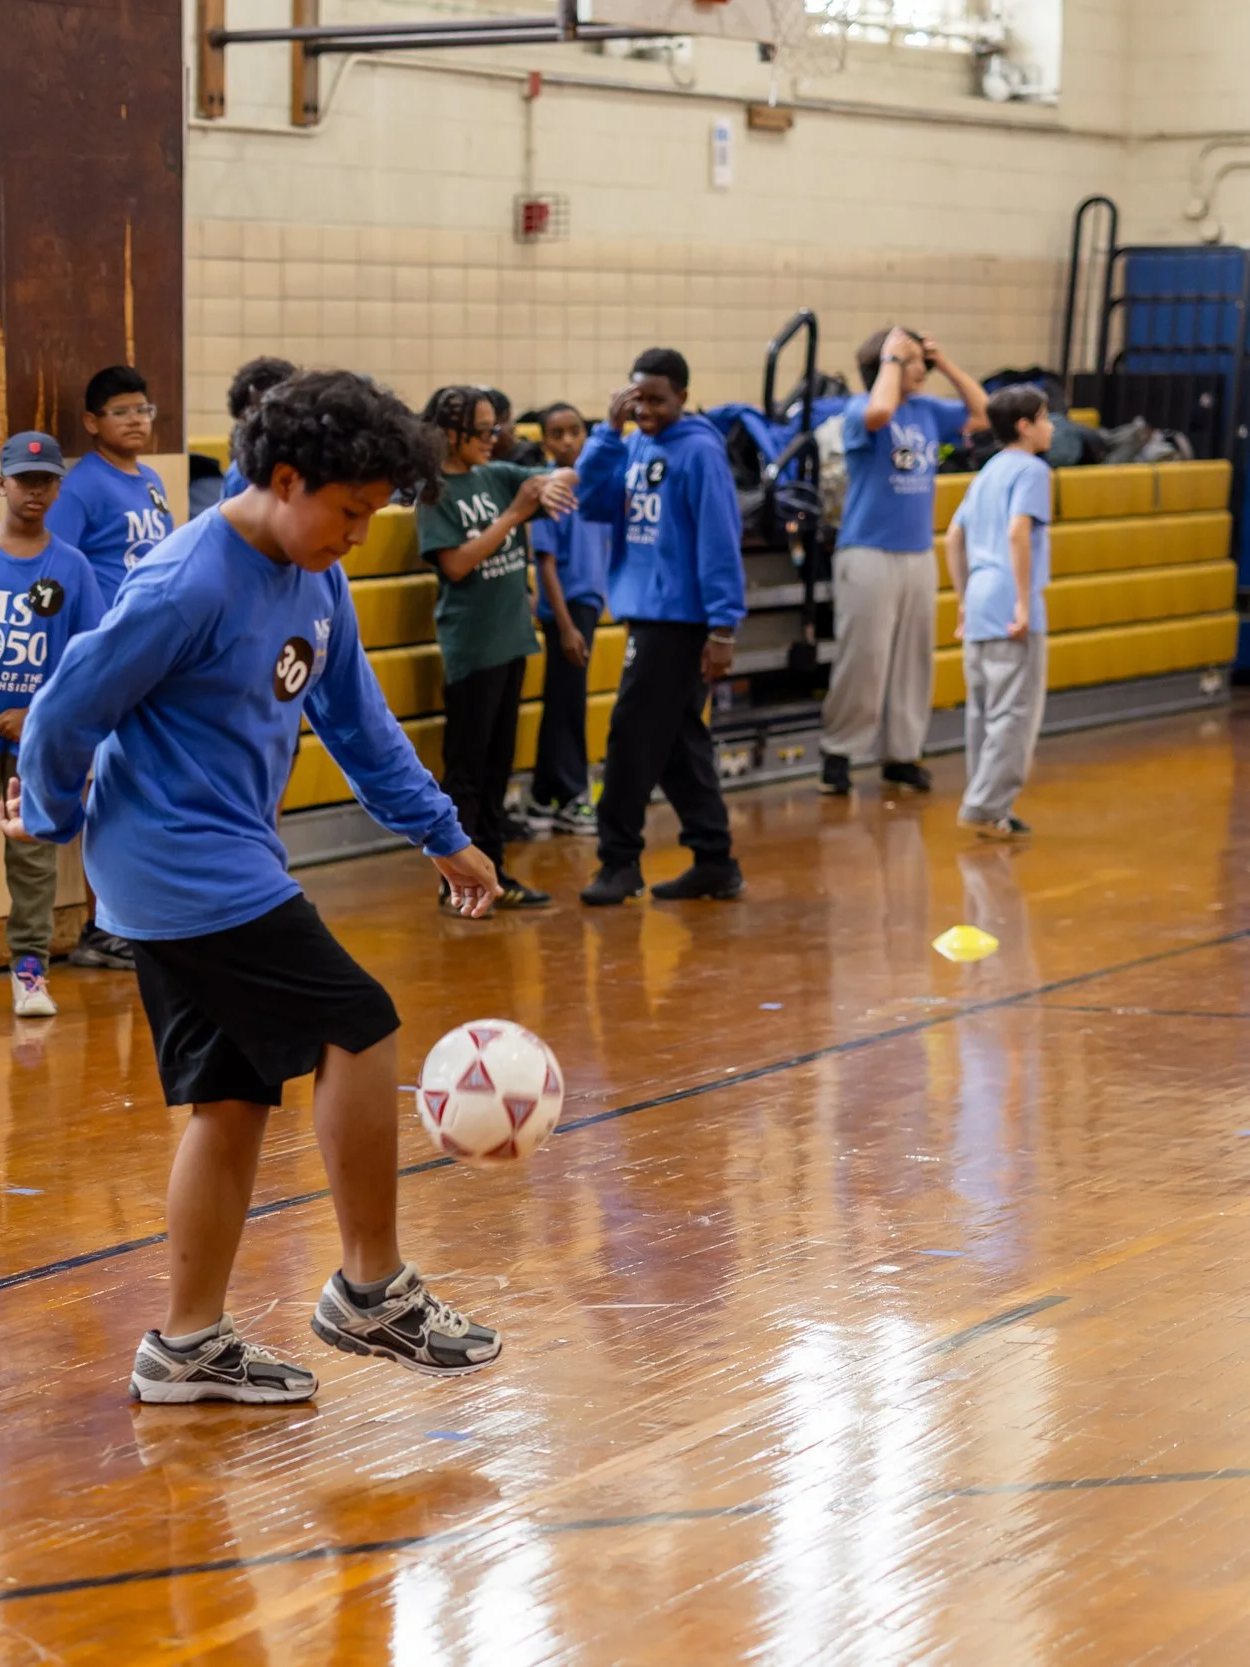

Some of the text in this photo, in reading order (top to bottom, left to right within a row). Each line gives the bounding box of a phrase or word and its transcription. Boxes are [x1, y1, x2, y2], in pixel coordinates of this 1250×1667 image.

[650, 462, 664, 482] 2
[456, 492, 500, 527] MS
[628, 492, 662, 523] 50
[124, 508, 166, 543] MS
[3, 630, 48, 667] 50
[1, 671, 19, 683] OF
[24, 673, 44, 684] THE
[276, 644, 298, 694] 30
